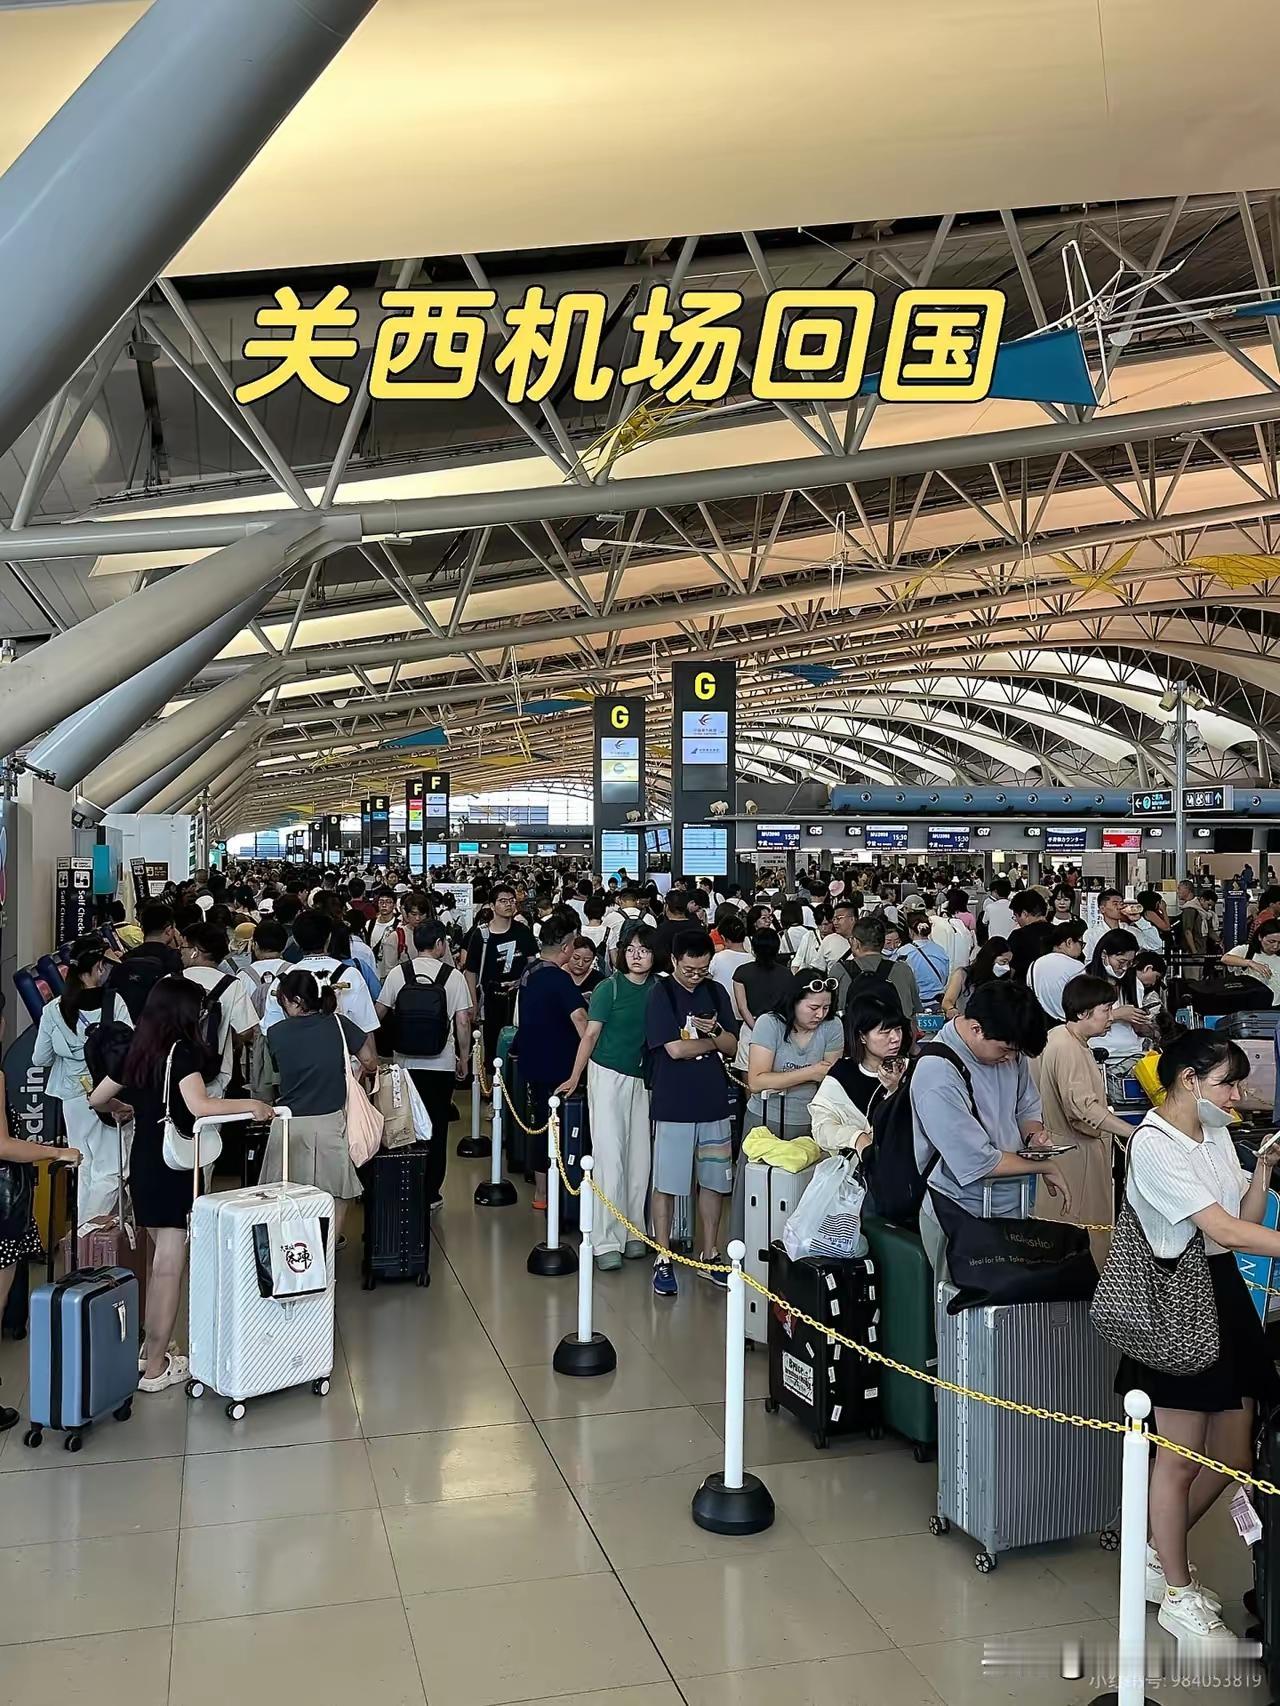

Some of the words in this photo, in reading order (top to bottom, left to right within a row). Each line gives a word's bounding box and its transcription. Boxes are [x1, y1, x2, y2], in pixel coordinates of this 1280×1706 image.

[694, 672, 716, 700] G
[610, 705, 629, 729] G
[431, 776, 441, 790] F
[413, 783, 423, 796] F
[376, 799, 384, 809] E
[810, 826, 823, 836] G15
[848, 827, 862, 837] G16
[977, 827, 991, 837] G17
[784, 833, 800, 841] 15:30
[954, 835, 969, 843] 15:30
[78, 890, 86, 906] Self
[496, 940, 517, 974] 7
